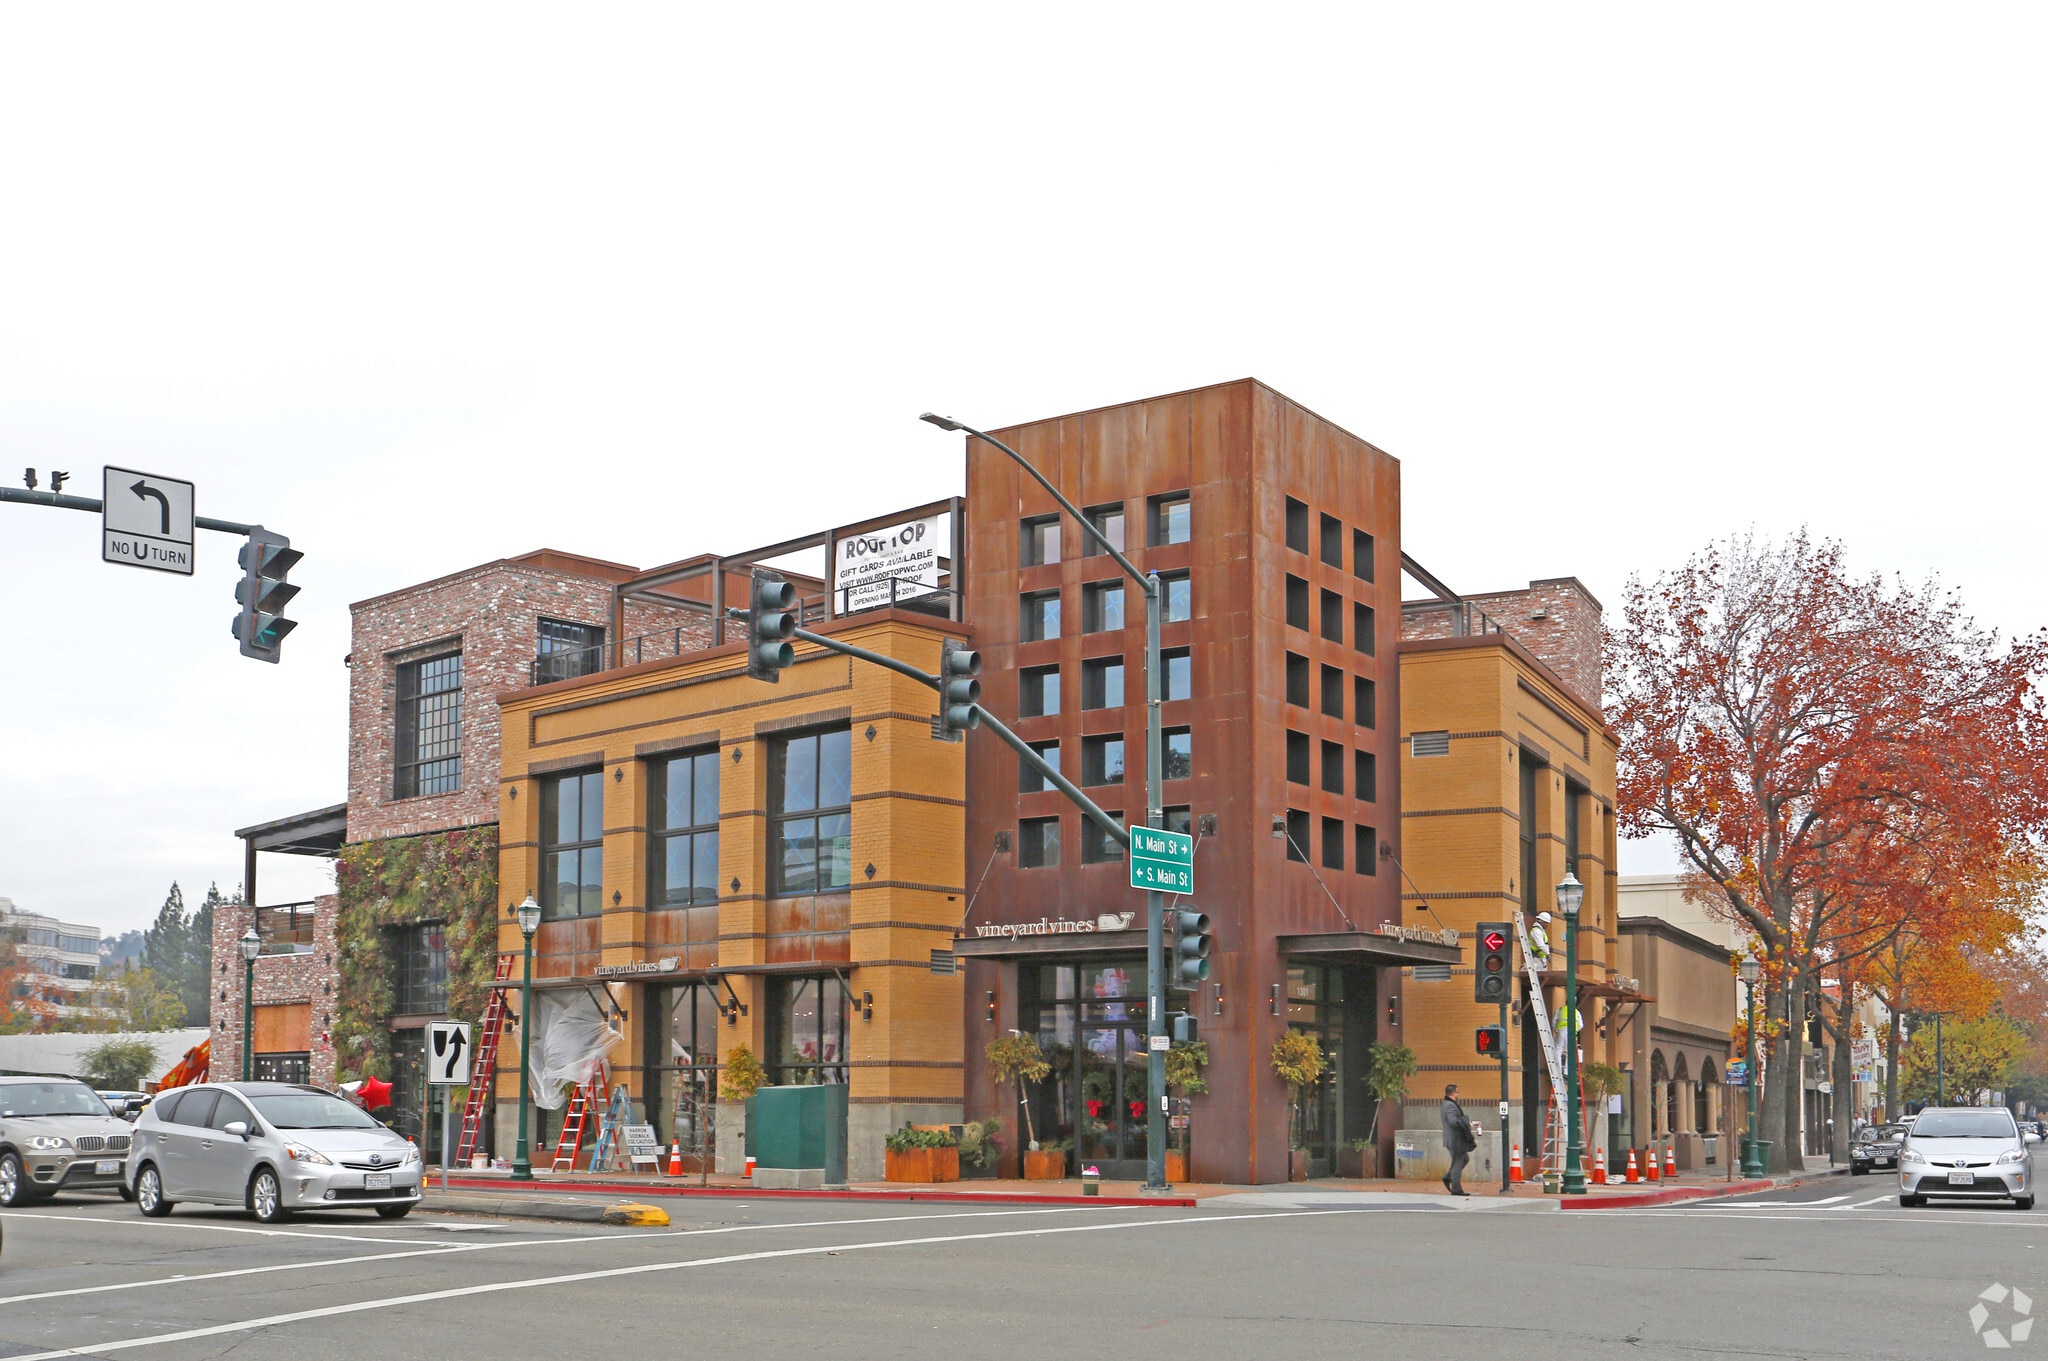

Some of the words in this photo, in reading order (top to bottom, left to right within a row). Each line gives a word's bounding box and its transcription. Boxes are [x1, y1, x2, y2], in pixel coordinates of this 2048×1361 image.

[112, 541, 129, 554] NO
[134, 542, 148, 560] U
[152, 547, 186, 564] TURN
[840, 568, 857, 578] GIFT
[859, 561, 884, 574] CARDS
[886, 549, 933, 567] AVAILABLE
[839, 579, 855, 589] VISIT
[856, 561, 933, 585] WWW.ROOFTOPWC.COM
[849, 589, 857, 597] OR
[859, 586, 874, 594] CALL
[876, 582, 889, 593] (925)
[854, 595, 879, 606] OPENING
[902, 586, 917, 595] 2016
[1135, 834, 1143, 849] N.
[1146, 836, 1165, 853] Main
[1168, 840, 1177, 855] St
[1147, 867, 1154, 882] S.
[1157, 868, 1176, 885] Main
[1179, 871, 1188, 886] St
[975, 917, 1048, 942] vineyard
[1048, 917, 1095, 934] vines
[593, 960, 634, 978] vineyard
